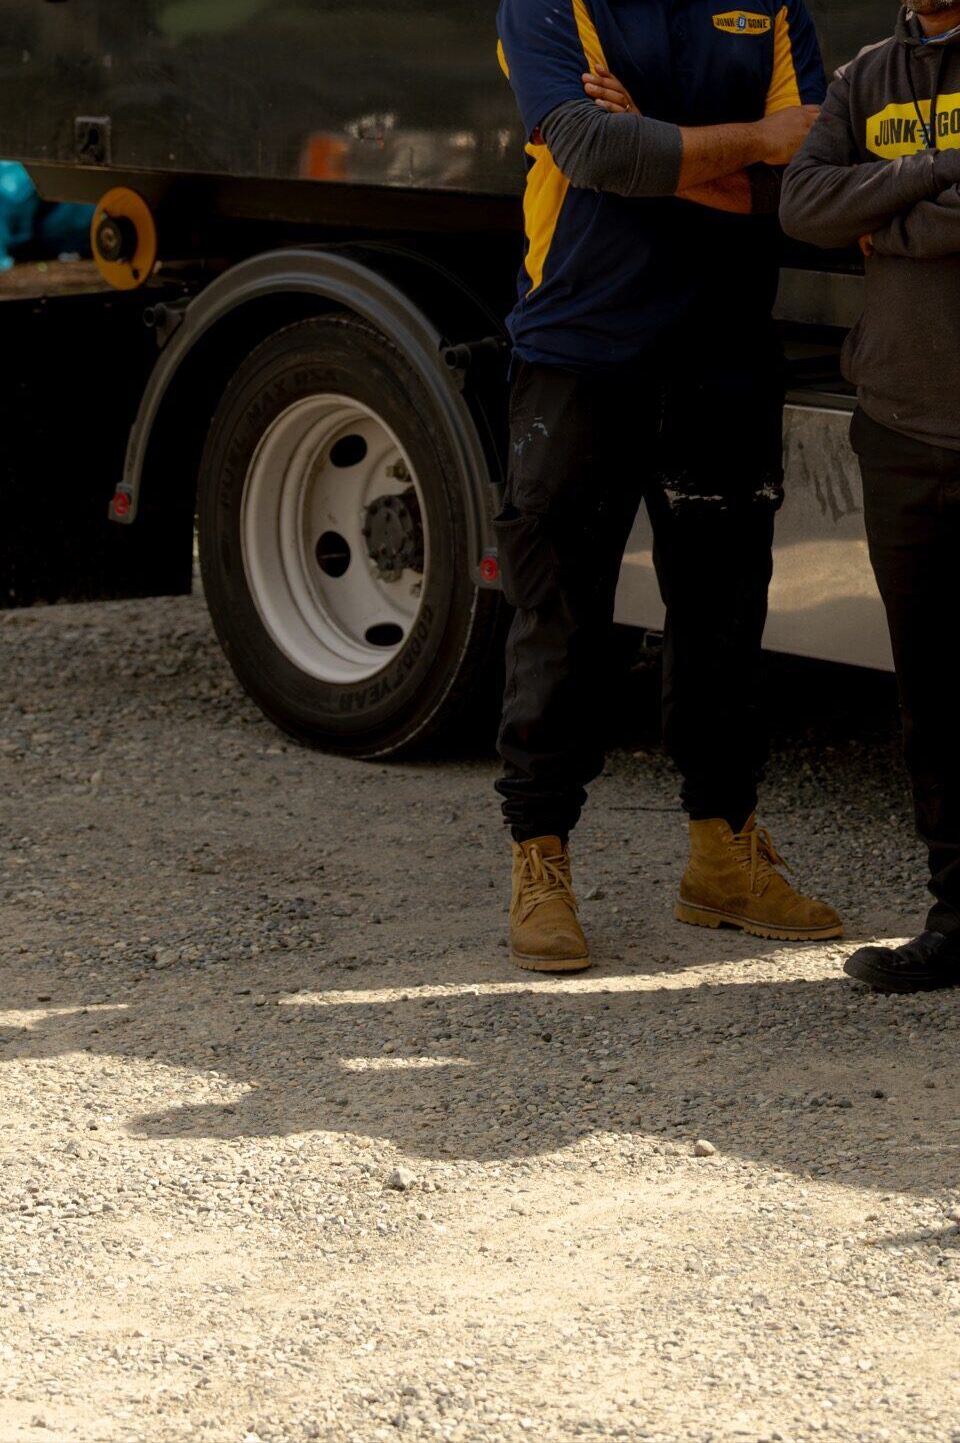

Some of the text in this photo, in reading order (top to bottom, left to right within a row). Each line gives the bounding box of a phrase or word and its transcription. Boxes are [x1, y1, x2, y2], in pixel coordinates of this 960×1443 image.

[715, 17, 736, 27] JUNK
[747, 18, 769, 29] GONE
[874, 118, 918, 147] JUNK
